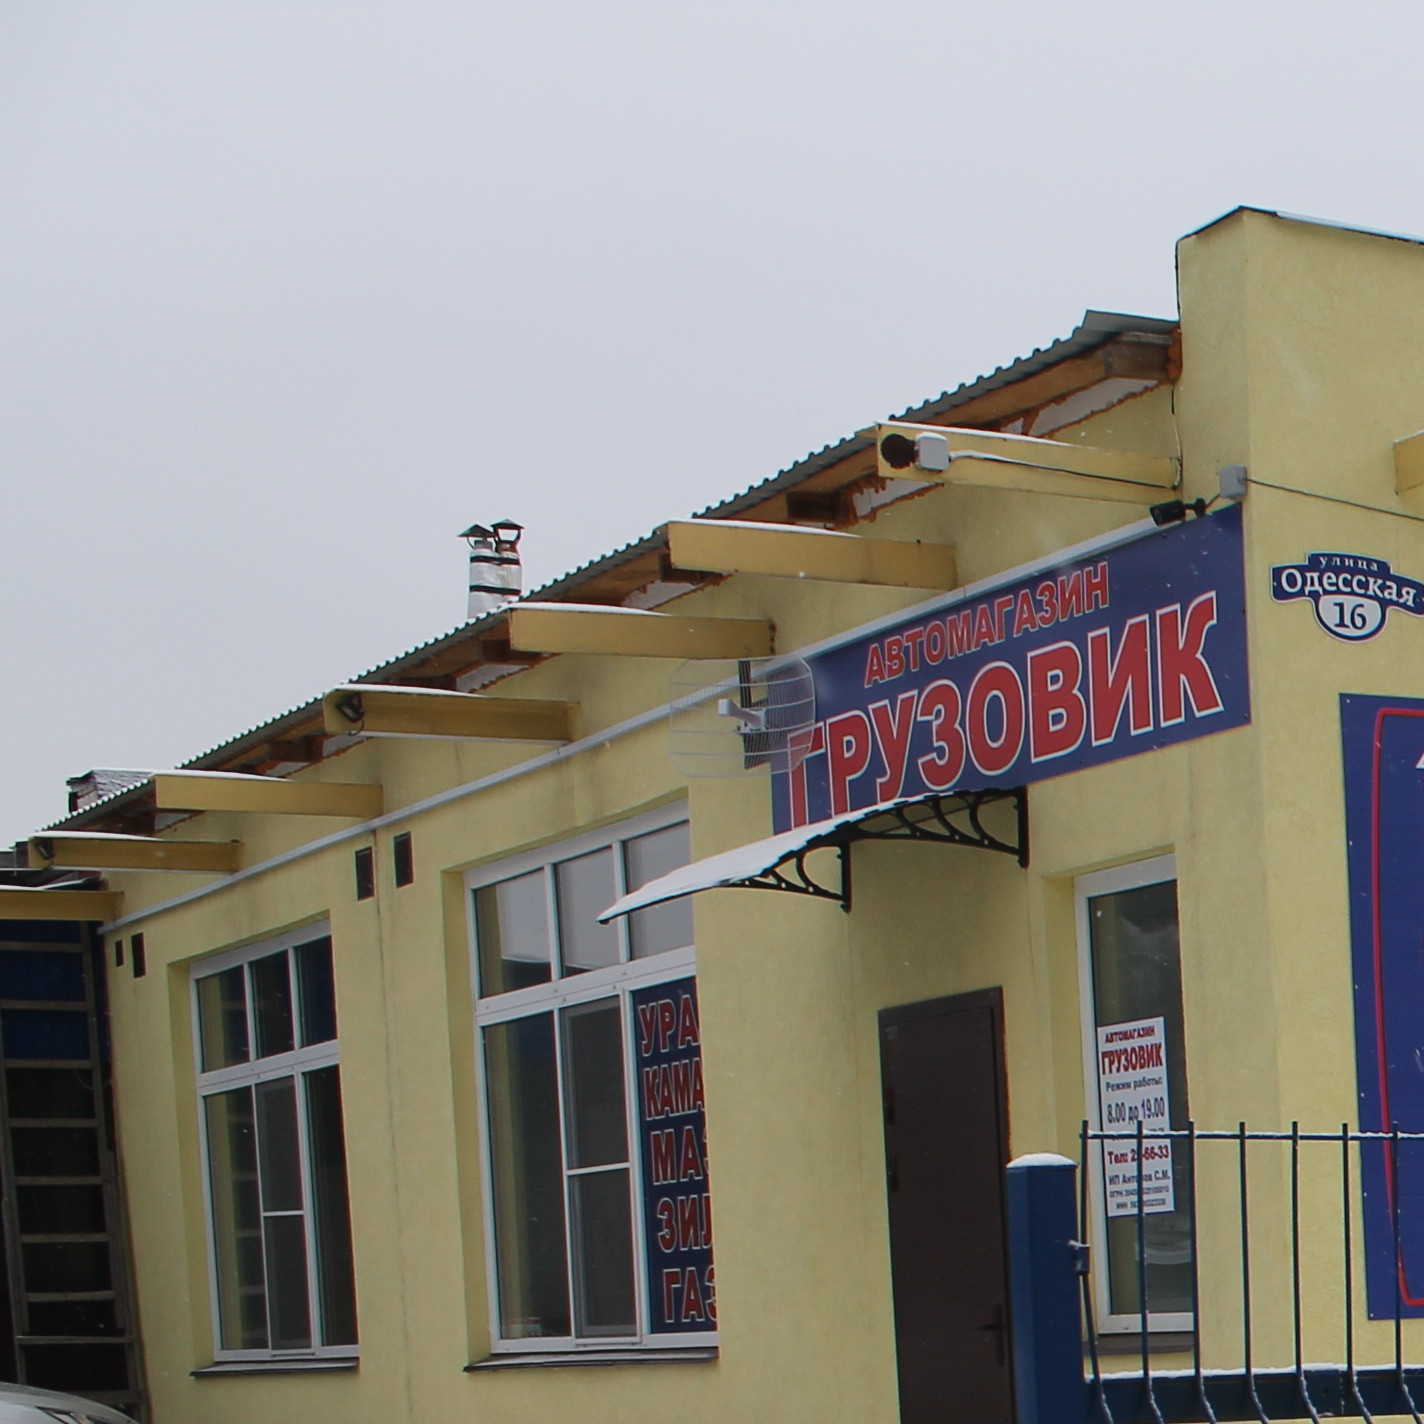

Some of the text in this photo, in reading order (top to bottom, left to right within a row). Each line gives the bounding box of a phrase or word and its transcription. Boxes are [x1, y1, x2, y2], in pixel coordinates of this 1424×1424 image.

[1319, 555, 1378, 571] улица
[1281, 568, 1417, 607] Одесская
[863, 561, 1110, 689] АВТОМАГАЗИН
[1332, 601, 1367, 630] 16
[787, 590, 1226, 832] ГРУЗОВИК
[1105, 1025, 1156, 1044] АВТОМАГАЗИН
[1101, 1042, 1163, 1075] ГРУЗОВИК
[1106, 1081, 1132, 1092] Режим
[1107, 1096, 1165, 1125] 8.00 до 19.00
[651, 1125, 709, 1186] МА
[1130, 1144, 1169, 1162] 2-66-33
